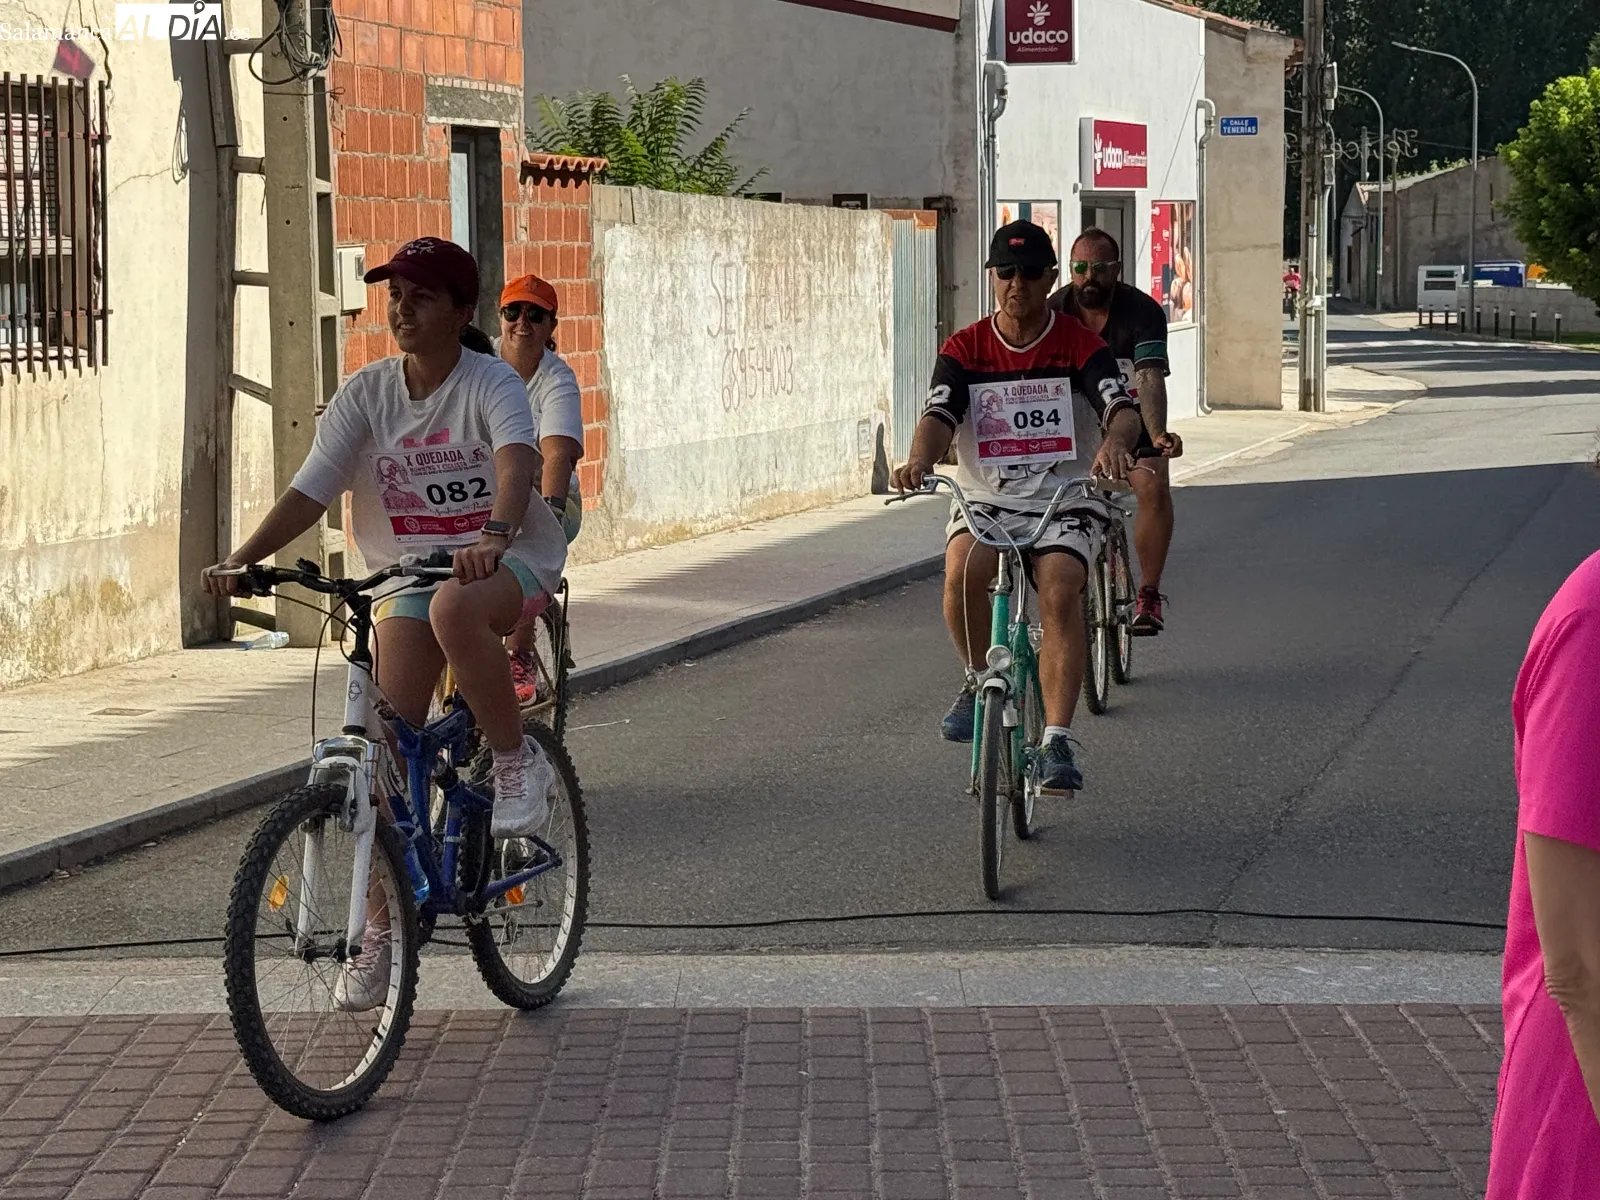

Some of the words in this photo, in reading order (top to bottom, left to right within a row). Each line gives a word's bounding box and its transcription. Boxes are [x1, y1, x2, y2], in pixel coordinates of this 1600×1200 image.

[1009, 27, 1069, 45] udaco
[1230, 119, 1248, 127] CALLE
[1103, 140, 1122, 169] udaco
[1003, 386, 1010, 397] X
[1012, 383, 1049, 396] QUEDADA
[1013, 408, 1061, 429] 084
[404, 455, 413, 467] X
[416, 449, 466, 465] QUEDADA
[426, 477, 492, 506] 082
